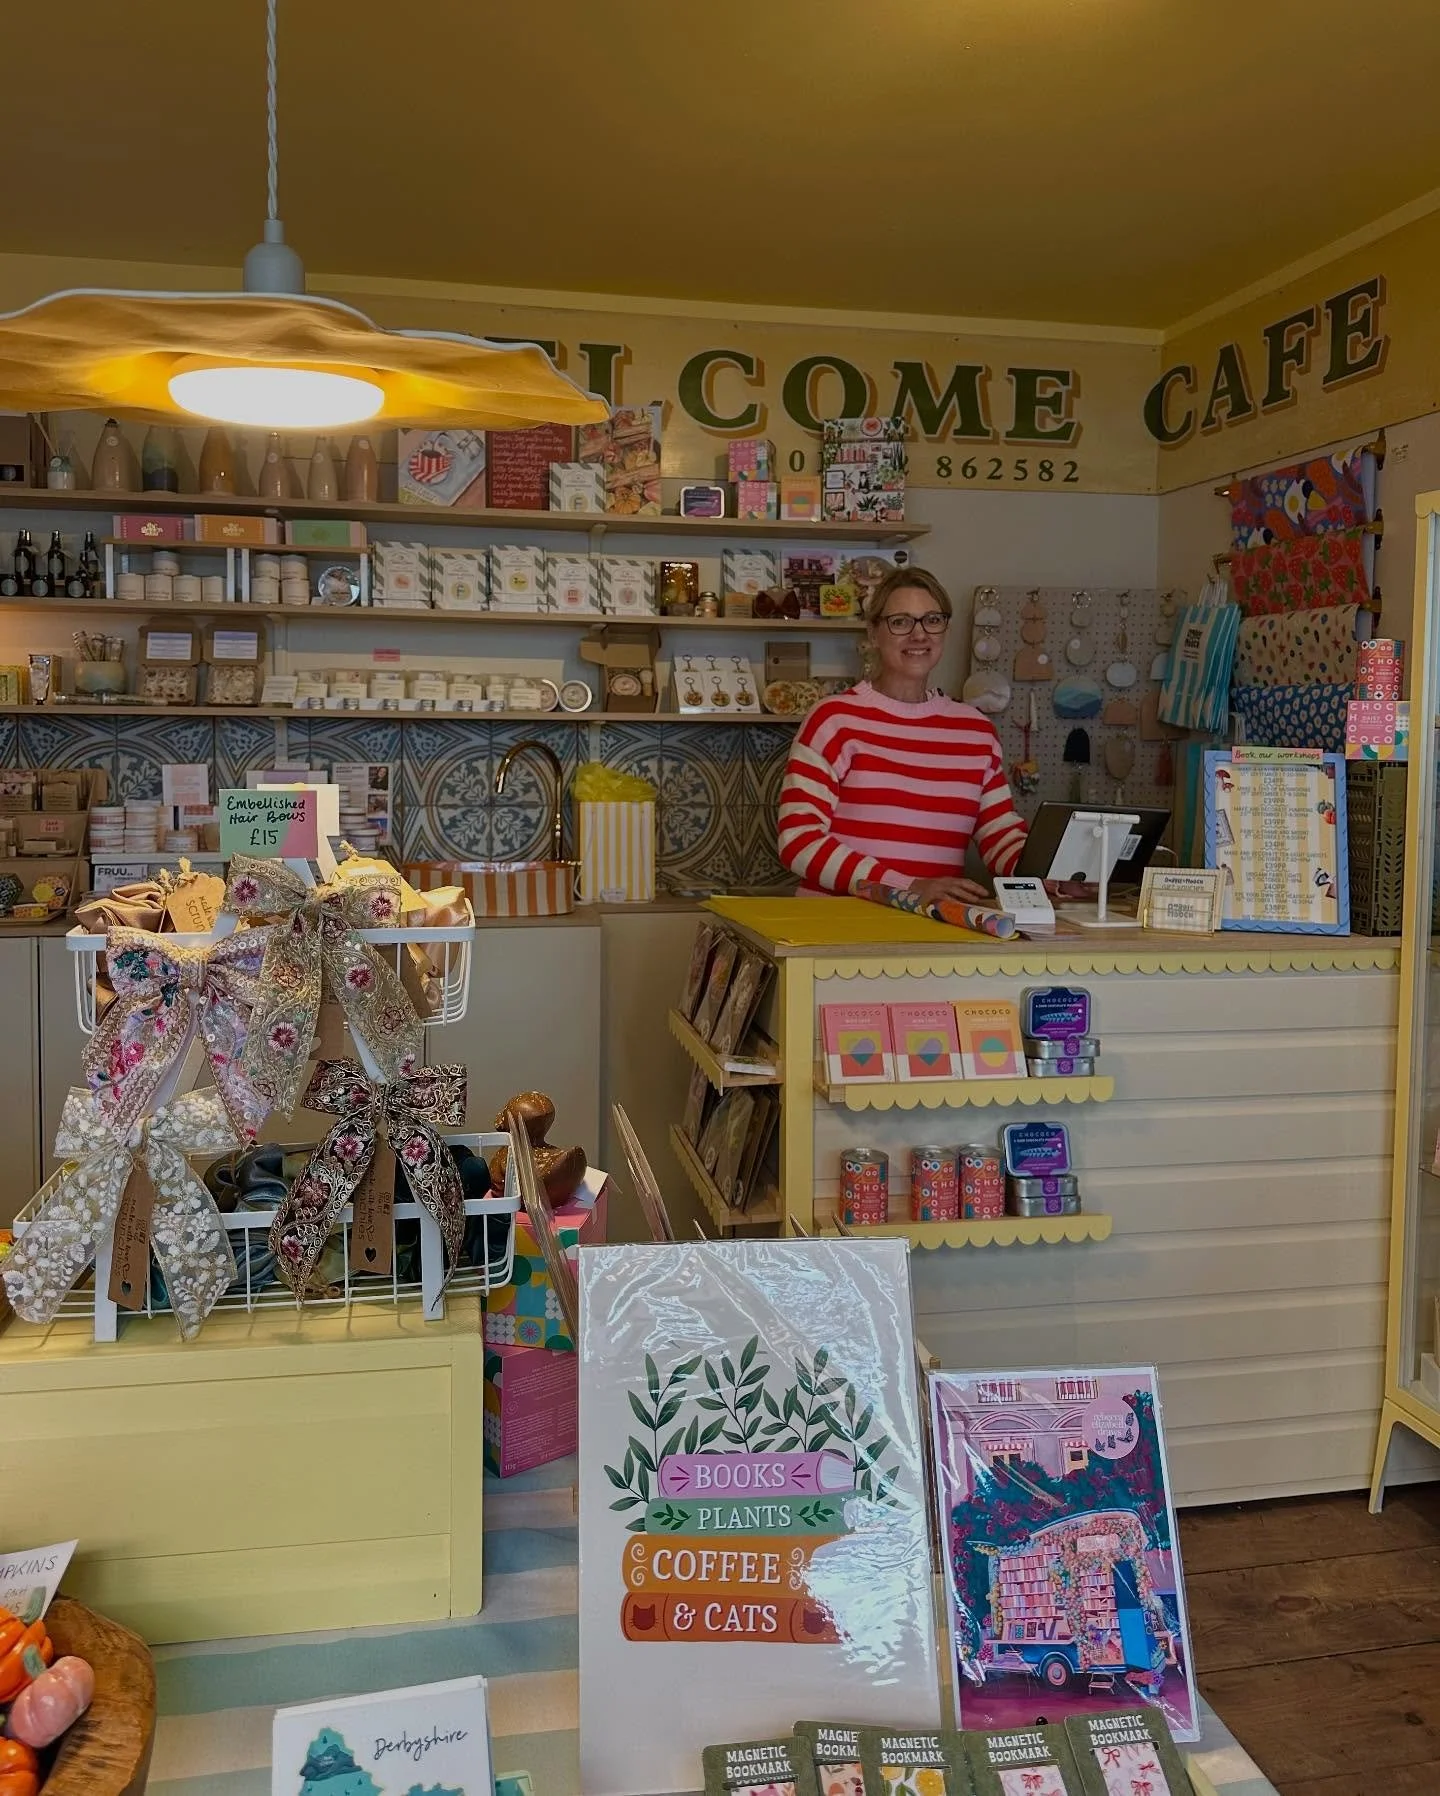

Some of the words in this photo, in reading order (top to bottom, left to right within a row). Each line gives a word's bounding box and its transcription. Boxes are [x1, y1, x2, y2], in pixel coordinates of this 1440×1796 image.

[1143, 274, 1391, 450] CAFE
[936, 455, 1080, 483] 862582
[226, 796, 306, 811] Embellished
[229, 810, 262, 825] Hair
[266, 809, 306, 823] Bows
[249, 829, 279, 847] £15
[185, 899, 206, 933] scrun
[694, 1463, 786, 1490] BOOKS
[697, 1505, 791, 1531] PLANTS
[652, 1549, 782, 1585] COFFEE
[673, 1602, 696, 1632] &
[704, 1603, 778, 1633] CATS
[1088, 1714, 1145, 1732] MAGNETIC
[373, 1726, 469, 1762] Derbyshire
[817, 1728, 859, 1743] MAGNE
[881, 1736, 940, 1750] MAGNETIC
[986, 1732, 1045, 1752] MAGNETIC
[1091, 1728, 1152, 1747] BOOKMARK
[726, 1745, 787, 1762] MAGNETIC
[816, 1742, 860, 1757] BOOKM
[881, 1750, 946, 1764] BOOKMARK
[987, 1745, 1052, 1763] BOOKMARK
[726, 1760, 793, 1779] BOOKMARK
